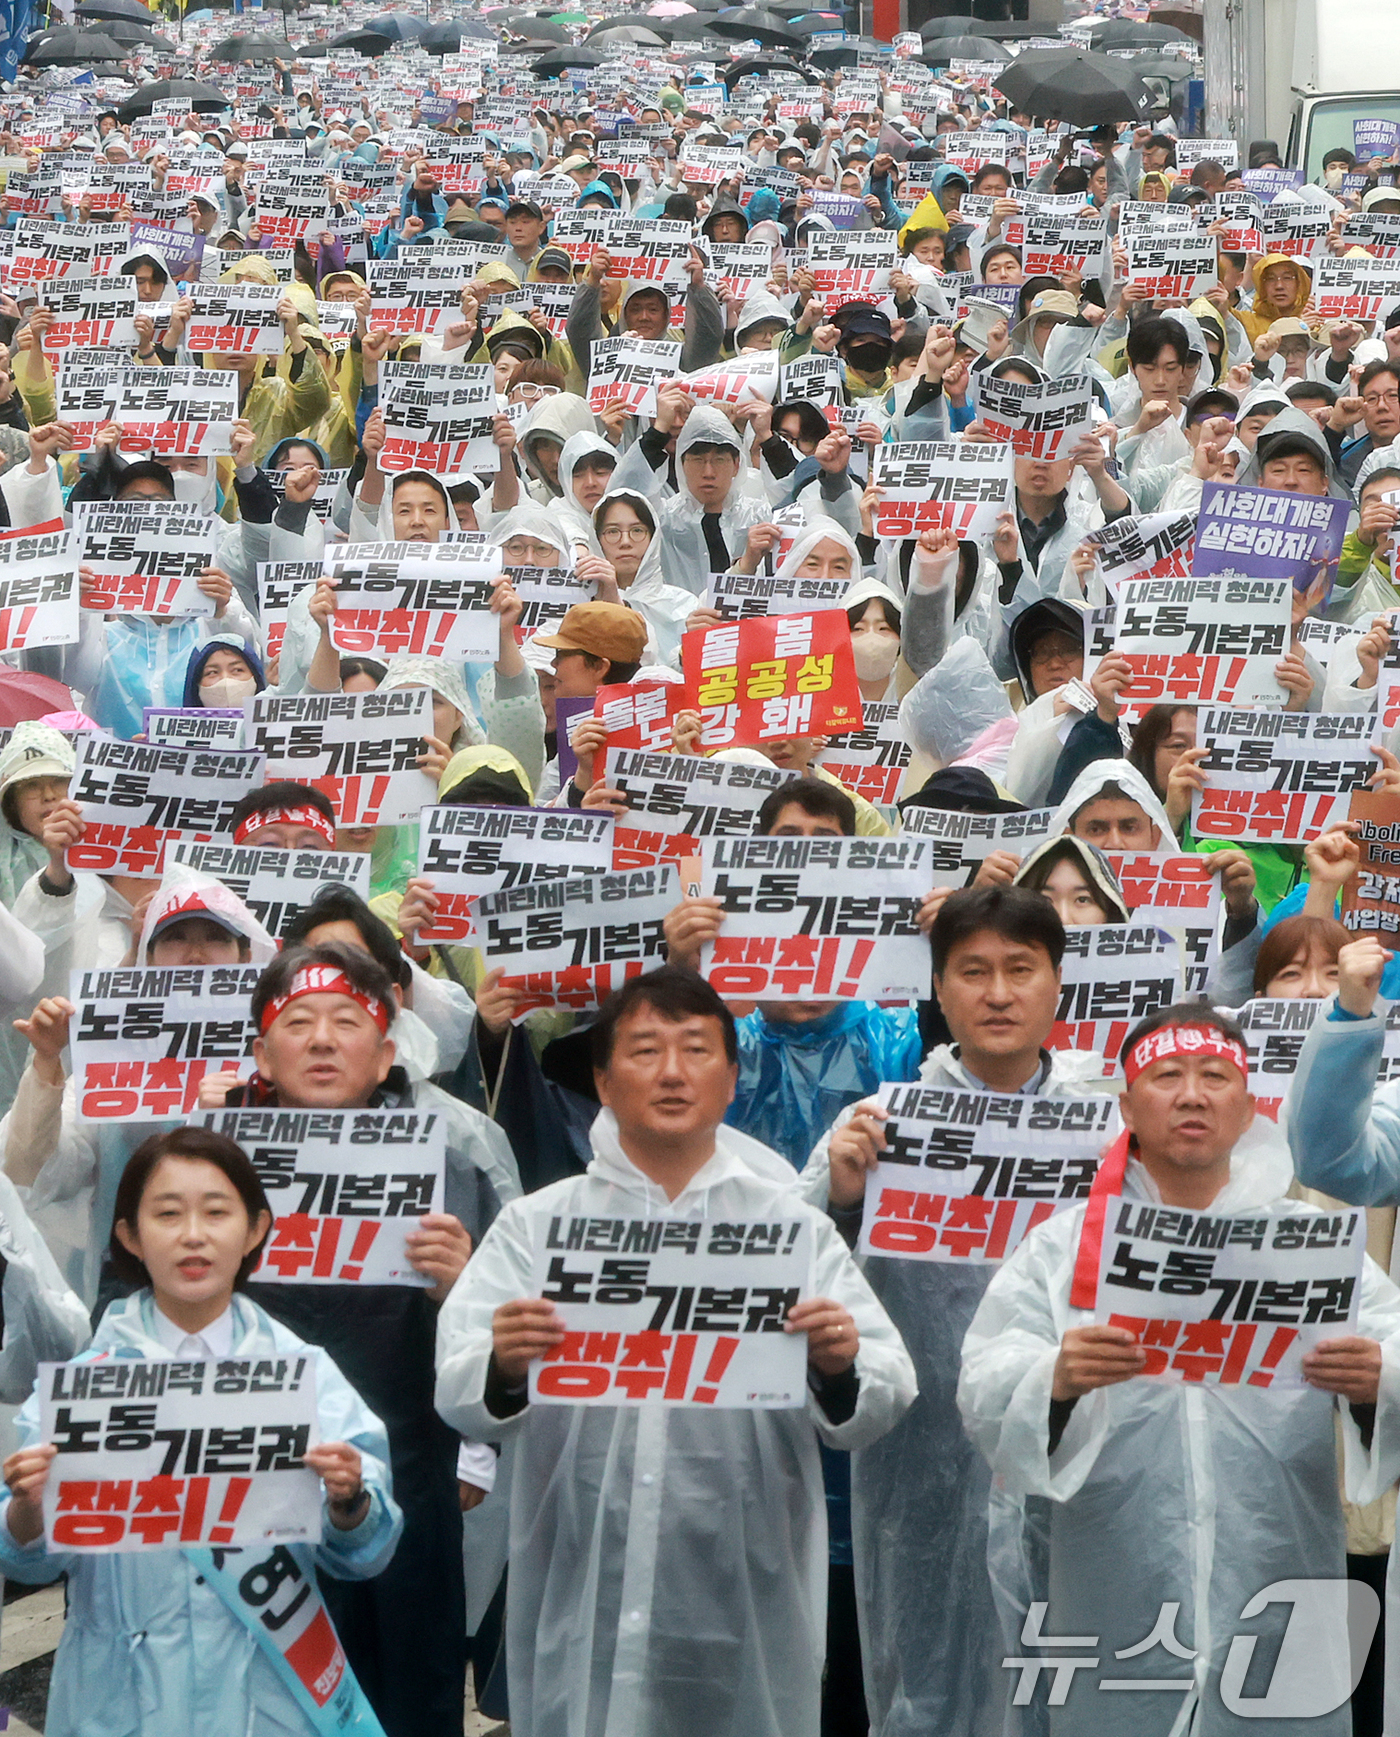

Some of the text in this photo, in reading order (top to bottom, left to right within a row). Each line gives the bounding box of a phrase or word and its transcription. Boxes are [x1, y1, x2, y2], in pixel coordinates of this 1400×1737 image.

[260, 184, 326, 198] 내란세력 청산!
[19, 220, 92, 237] 내란세력 청산!
[608, 220, 688, 233] 내란세력 청산!
[812, 232, 894, 243] 내란세력 청산!
[1028, 218, 1104, 230] 내란세력 청산!
[1132, 238, 1213, 251] 내란세력 청산!
[370, 267, 460, 279] 내란세력 청산!
[605, 257, 670, 280] 쟁취!
[1320, 259, 1364, 270] 내란세력
[42, 277, 131, 294] 내란세력 청산!
[189, 286, 282, 299] 내란세력 청산!
[815, 269, 875, 291] 쟁취!
[1319, 294, 1382, 319] 쟁취!
[45, 320, 114, 347] 쟁취!
[369, 308, 441, 333] 쟁취!
[188, 325, 260, 352] 쟁취!
[122, 371, 233, 387] 내란세력 청산!
[384, 362, 488, 380] 내란세력 청산!
[452, 385, 490, 404] 청산!
[979, 374, 1088, 399] 내란세력 청산!
[380, 438, 469, 472] 쟁취!
[879, 444, 1006, 463] 내란세력 청산!
[1205, 490, 1334, 531] 사회대개혁
[85, 516, 211, 537] 내란세력 청산!
[16, 532, 71, 562] 청산!
[332, 542, 430, 561] 내란세력
[1200, 521, 1318, 561] 실현하자!
[714, 574, 849, 599] 내란세력 청산!
[1125, 581, 1287, 604] 내란세력 청산!
[333, 608, 458, 656] 쟁취!
[1118, 653, 1247, 703] 쟁취!
[252, 691, 424, 723] 내란세력 청산!
[156, 717, 237, 739] 내란세력
[1204, 711, 1377, 739] 내란세력 청산!
[82, 741, 261, 780] 내란세력 청산!
[614, 751, 724, 786] 내란세력
[427, 809, 609, 842] 내란세력 청산!
[904, 811, 996, 839] 내란세력
[292, 854, 366, 882] 청산!
[717, 839, 837, 870] 내란세력
[849, 840, 926, 870] 청산!
[479, 879, 594, 916] 내란세력
[600, 868, 670, 902] 청산!
[707, 934, 875, 998] 쟁취!
[80, 969, 203, 999] 내란세력
[1134, 1028, 1177, 1068] 단결
[887, 1088, 1113, 1132] 내란세력 청산!
[349, 1114, 438, 1144] 청산!
[546, 1217, 802, 1255] 내란세력 청산!
[1115, 1203, 1359, 1251] 내란세력 청산!
[51, 1359, 306, 1401] 내란세력 청산!
[536, 1330, 740, 1404] 쟁취!
[52, 1475, 252, 1546] 쟁취!
